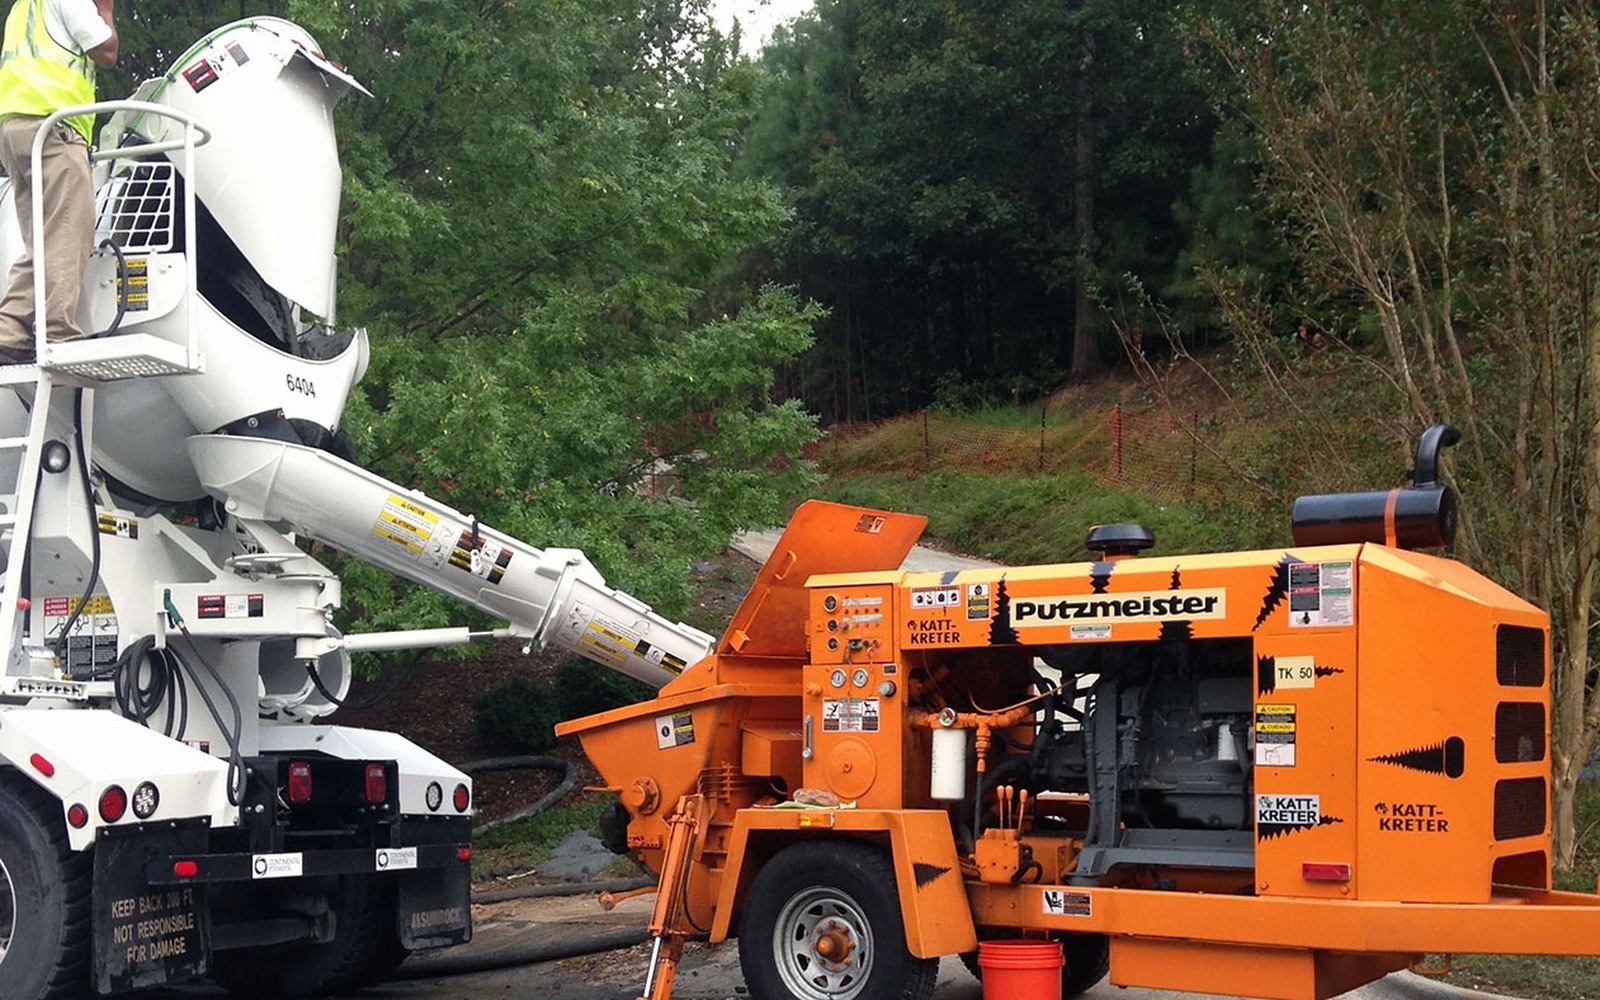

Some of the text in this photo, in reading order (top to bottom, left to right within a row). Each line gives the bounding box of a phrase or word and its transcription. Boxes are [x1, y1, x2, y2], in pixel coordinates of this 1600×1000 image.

[286, 374, 316, 398] 6404
[1015, 596, 1218, 620] Putzmeister
[920, 620, 957, 631] KATT-
[911, 632, 960, 644] KRETER
[1278, 667, 1313, 679] TK 50
[1276, 798, 1317, 810] KATT-
[1392, 804, 1443, 817] KATT-
[1259, 810, 1317, 822] KRETER
[1379, 818, 1449, 832] KRETER
[111, 898, 135, 918] KEEP
[140, 895, 163, 913] BACK
[114, 913, 194, 943] NOT RESPONSIBLE
[127, 937, 186, 963] FOR DAMAGE
